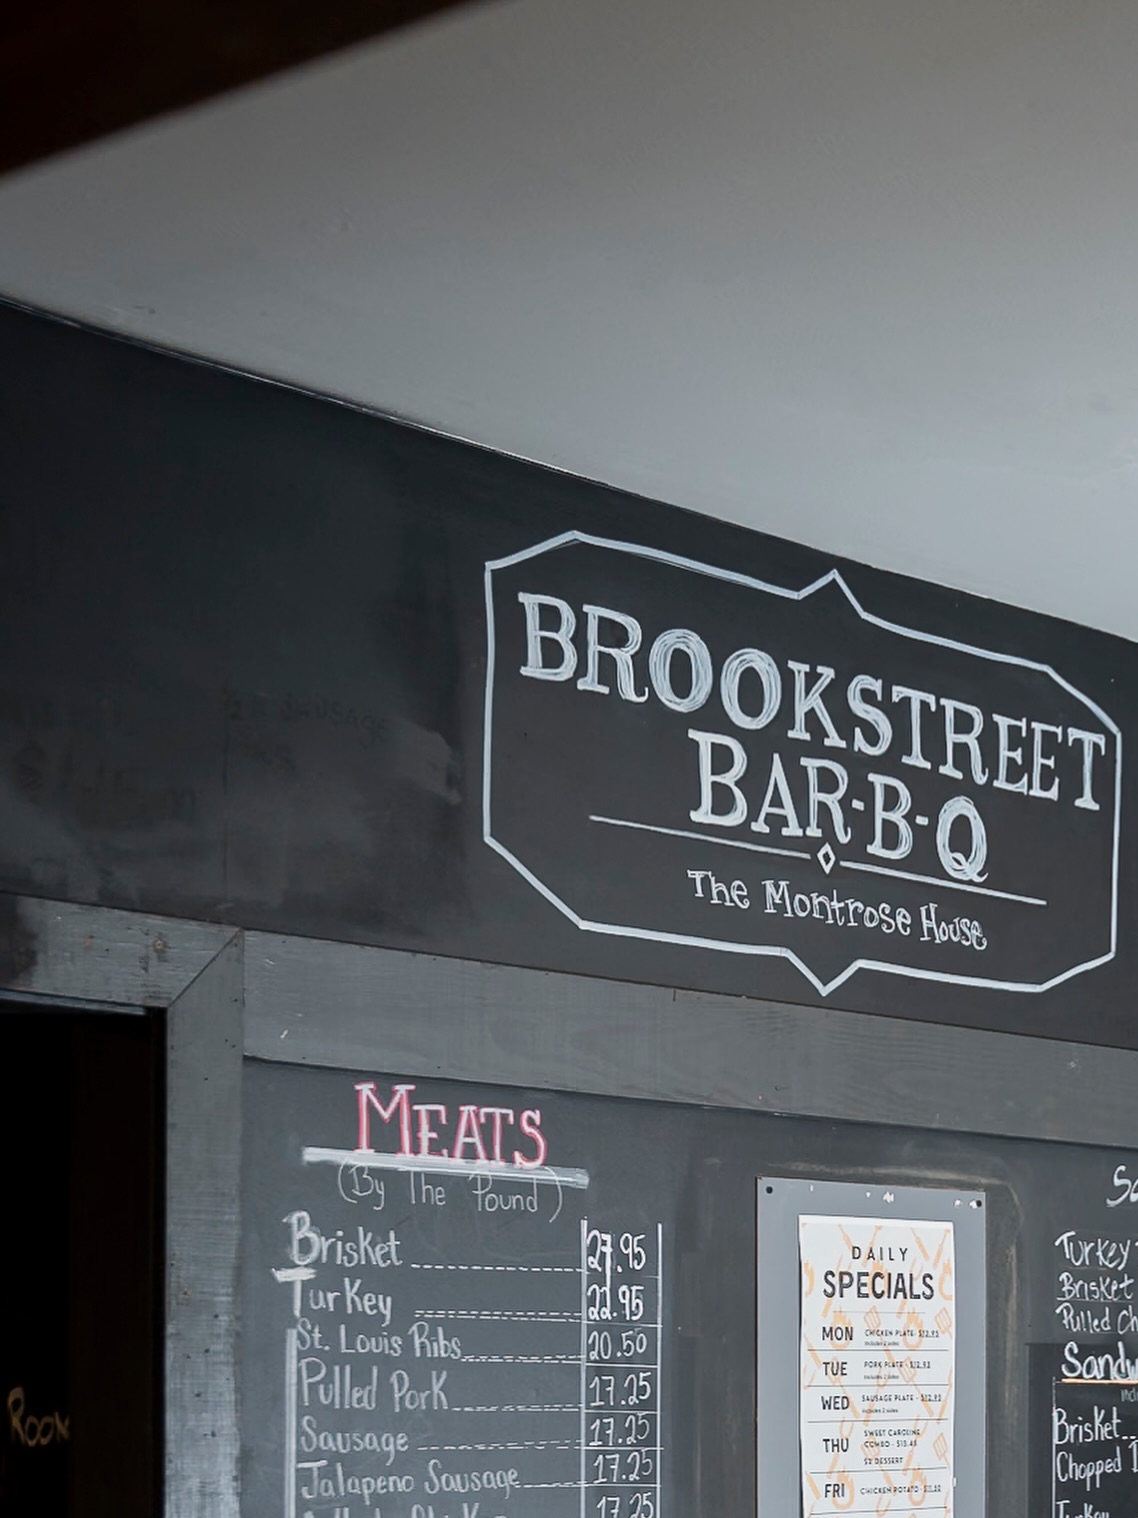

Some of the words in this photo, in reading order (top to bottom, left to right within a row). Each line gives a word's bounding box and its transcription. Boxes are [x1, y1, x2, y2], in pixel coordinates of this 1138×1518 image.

[518, 591, 1106, 811] BROOKSTREET
[687, 728, 989, 883] BAR-B-Q
[687, 869, 749, 909] The
[763, 879, 912, 938] Montrose
[918, 903, 989, 951] House
[354, 1082, 548, 1168] MEATS
[410, 1169, 446, 1206] The
[282, 1211, 403, 1267] Brisket
[852, 1246, 908, 1262] DAILY
[1055, 1230, 1131, 1270] Turkey
[272, 1267, 392, 1326] Turkey
[588, 1284, 644, 1321] 22.95
[823, 1270, 934, 1300] SPECIALS
[1056, 1272, 1134, 1301] Brisket
[822, 1326, 854, 1341] MON
[864, 1329, 893, 1337] CHICKEN
[895, 1329, 914, 1337] PLATE
[1055, 1302, 1111, 1333] Pulled
[296, 1318, 330, 1352] St.
[340, 1324, 402, 1357] Louis
[408, 1322, 462, 1359] Ribs
[588, 1329, 648, 1360] 20.50
[299, 1358, 378, 1410] Pulled
[390, 1369, 449, 1412] Pork
[589, 1371, 652, 1406] 17.25
[823, 1362, 848, 1376] TUE
[821, 1396, 850, 1410] WED
[862, 1394, 892, 1402] SAUSAGE
[300, 1416, 409, 1466] Sausage
[589, 1413, 651, 1446] 17.25
[864, 1429, 886, 1437] SWEET
[888, 1428, 920, 1437] CAROLINE
[1053, 1406, 1122, 1444] Brisket
[823, 1438, 849, 1453] THU
[864, 1440, 890, 1448] COMBO
[874, 1457, 903, 1465] DESSERT
[298, 1460, 414, 1505] Jalapeno
[424, 1459, 519, 1499] Sausage
[593, 1449, 654, 1484] 17.25
[1056, 1446, 1122, 1491] Chopped
[824, 1483, 845, 1498] FRI
